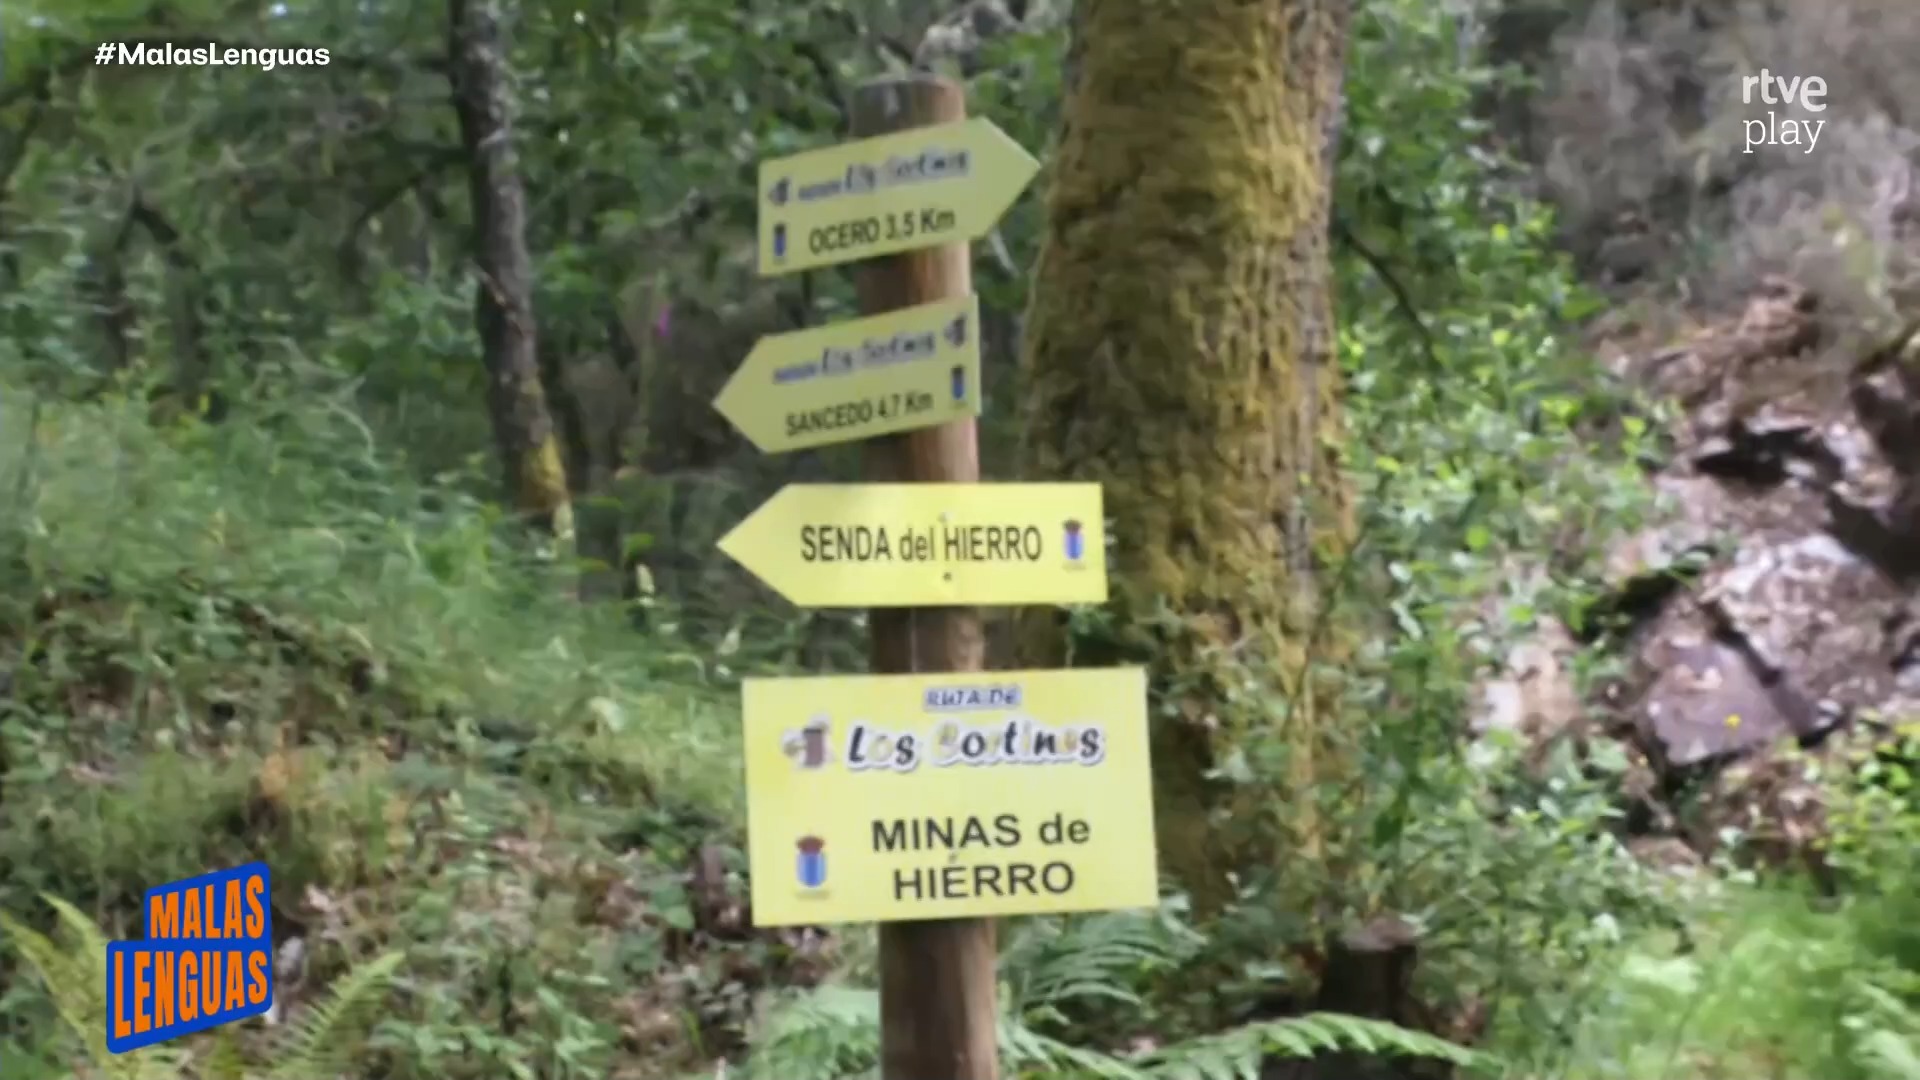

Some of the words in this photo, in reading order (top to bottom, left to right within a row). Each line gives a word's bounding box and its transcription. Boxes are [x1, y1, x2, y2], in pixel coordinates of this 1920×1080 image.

[809, 216, 880, 255] OCERO
[920, 206, 956, 233] Km
[785, 398, 873, 437] SANCEDO
[905, 390, 935, 414] Km
[801, 525, 892, 562] SENDA
[900, 525, 934, 561] del
[944, 525, 1042, 562] HIERRO
[871, 814, 1022, 852] MINAS
[1038, 813, 1091, 845] de
[893, 861, 1075, 901] HIERRO
